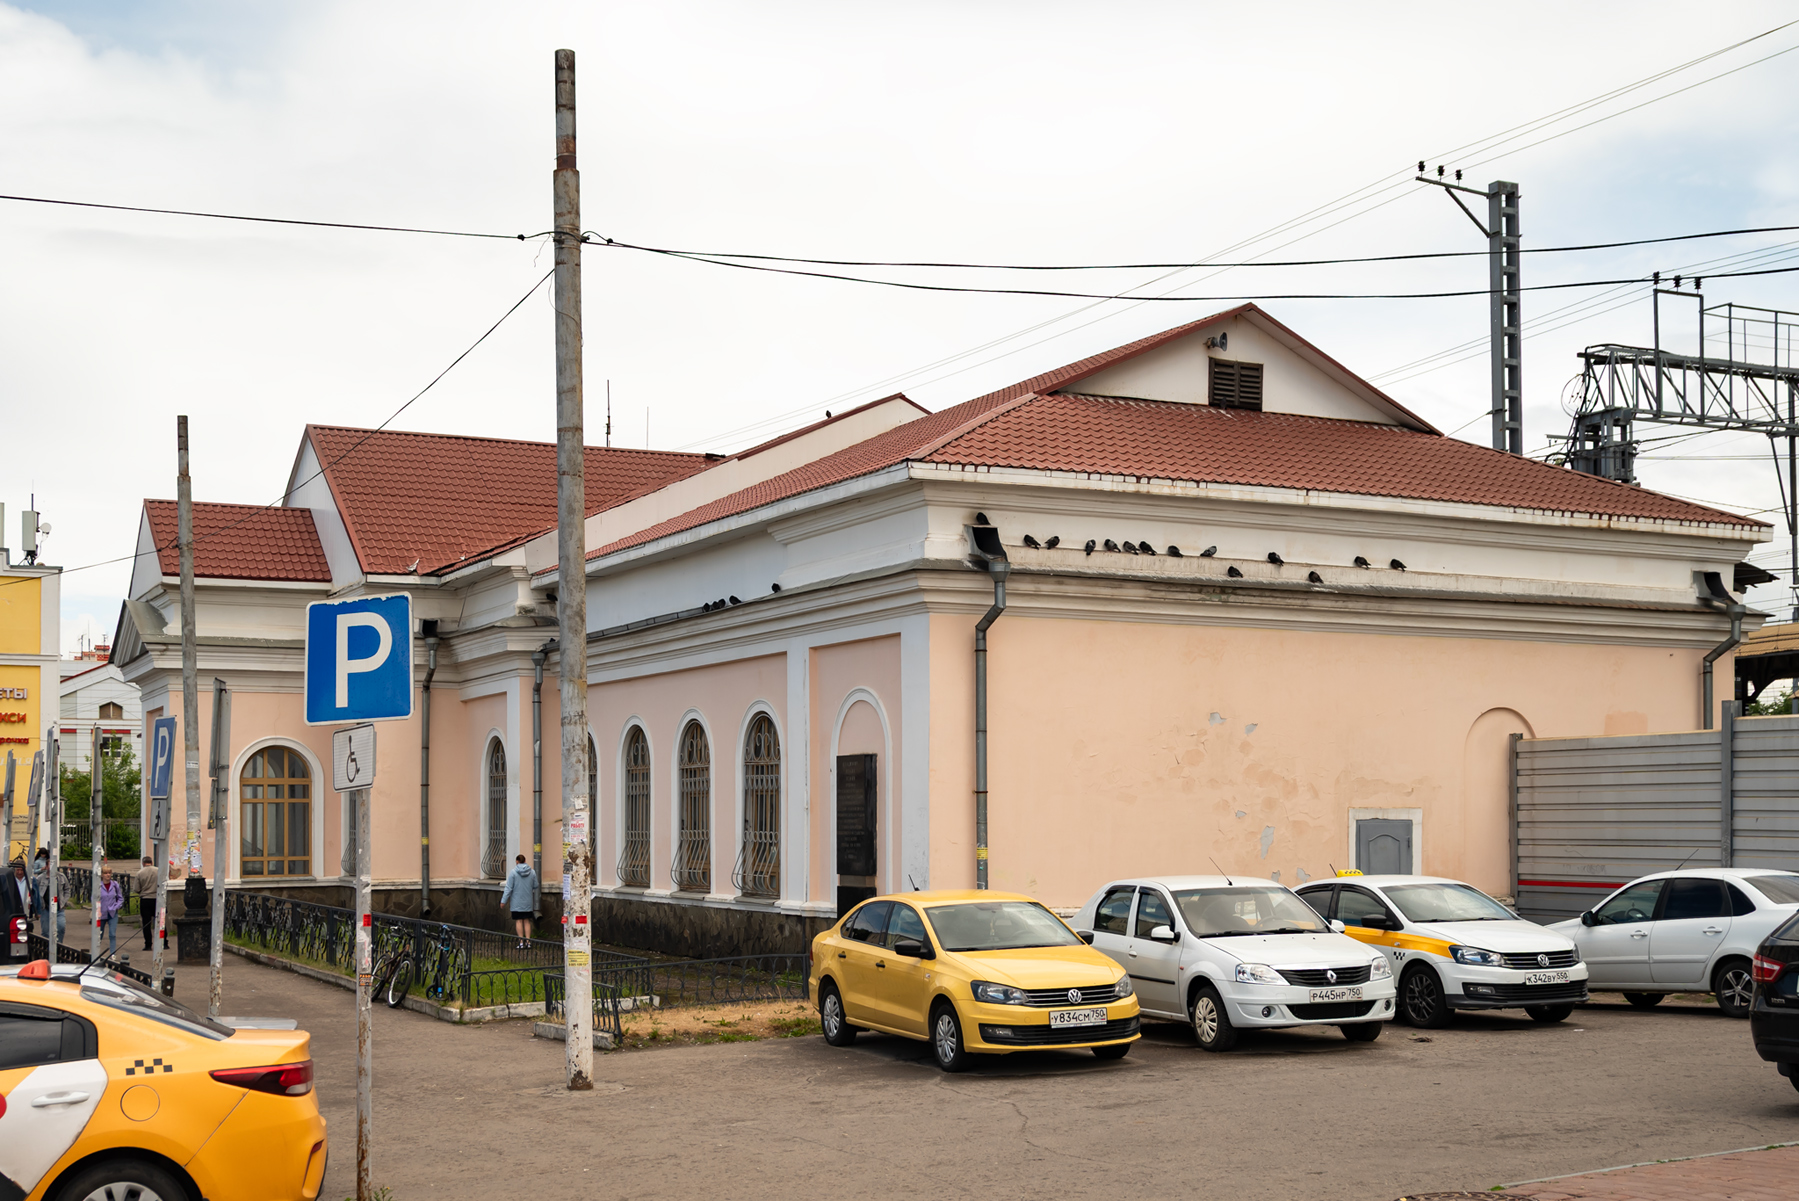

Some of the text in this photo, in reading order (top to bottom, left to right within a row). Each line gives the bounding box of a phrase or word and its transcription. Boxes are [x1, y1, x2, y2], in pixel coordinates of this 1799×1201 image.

[335, 611, 393, 709] P
[154, 726, 170, 789] P
[1312, 990, 1346, 1001] Р445НР
[1347, 988, 1361, 996] 750
[1053, 1009, 1104, 1024] У834СМ 750
